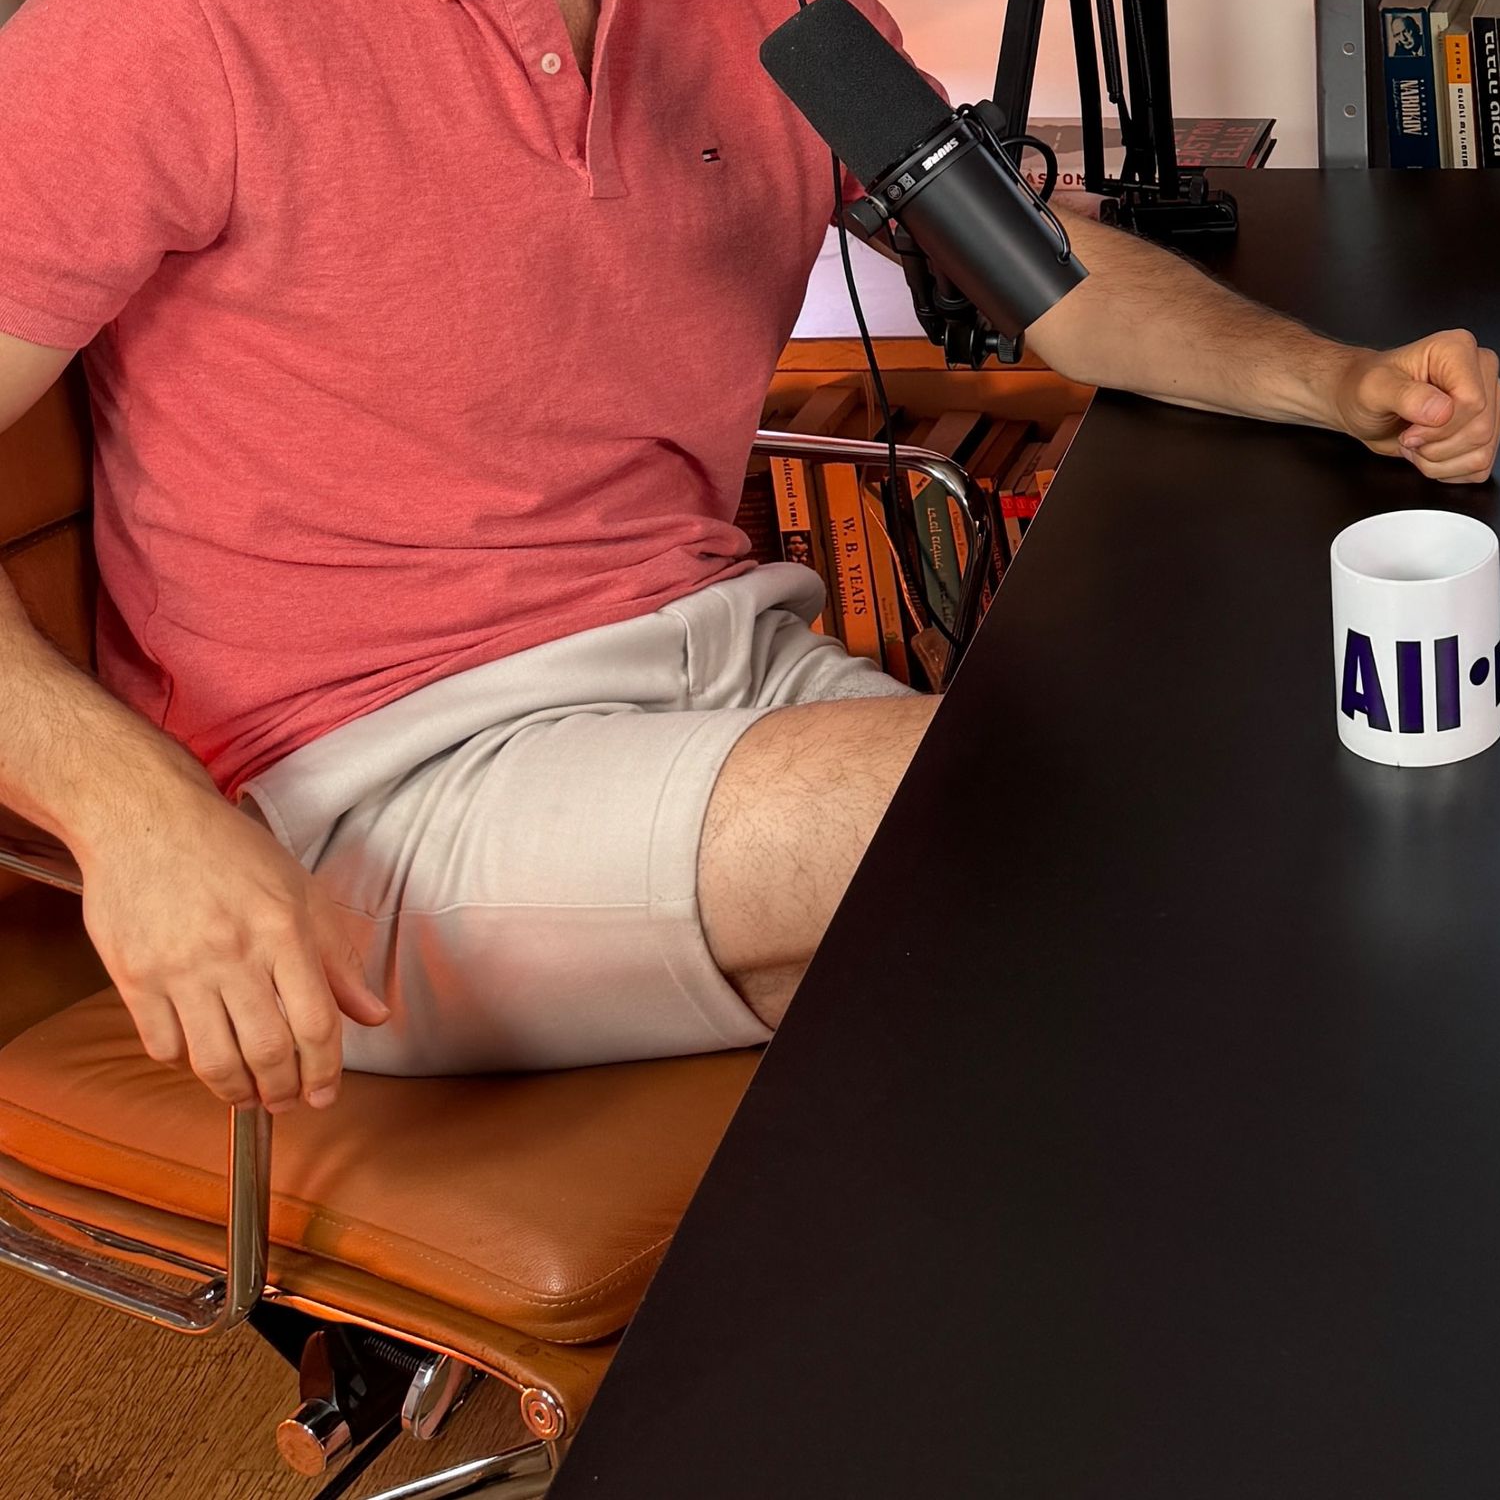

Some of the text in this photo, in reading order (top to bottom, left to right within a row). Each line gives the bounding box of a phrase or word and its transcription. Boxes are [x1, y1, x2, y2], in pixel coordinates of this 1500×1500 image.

[1484, 30, 1499, 94] ברברה
[1400, 79, 1423, 136] NABOKOV
[921, 137, 959, 171] SHURE
[842, 516, 867, 616] W. B. YEATS
